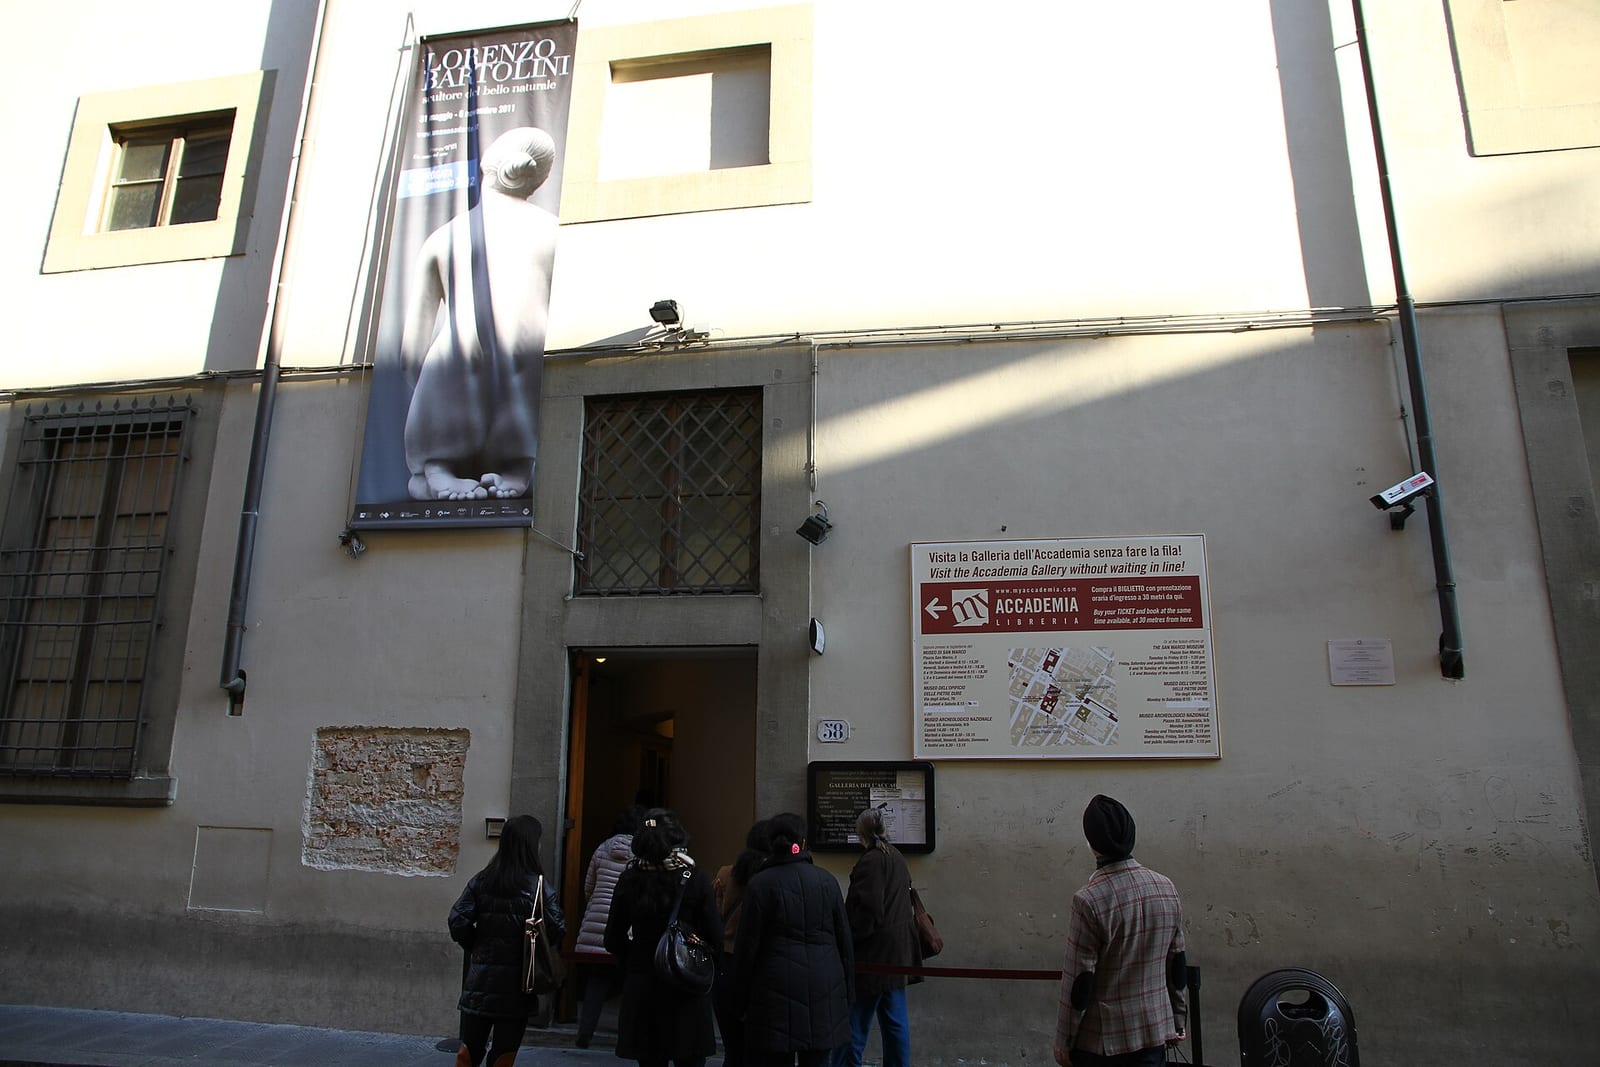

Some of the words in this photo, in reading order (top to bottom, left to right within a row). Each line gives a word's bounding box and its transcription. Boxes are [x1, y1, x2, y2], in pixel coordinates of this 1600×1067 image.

[427, 38, 556, 73] LORENZO
[422, 55, 571, 91] BARTOLINI
[481, 84, 510, 97] bello
[512, 80, 556, 94] naturale
[499, 103, 516, 113] 2011
[929, 552, 956, 563] Visita
[959, 551, 968, 562] la
[971, 550, 1010, 562] Galleria
[1013, 548, 1090, 560] dell'Accademia
[1093, 549, 1123, 558] senza
[1126, 546, 1147, 557] fare
[1150, 546, 1159, 556] la
[1162, 545, 1182, 556] fila!
[930, 567, 951, 579] Visit
[954, 567, 970, 578] the
[972, 565, 1028, 578] Accademia
[1031, 564, 1067, 577] Gallery
[1070, 562, 1108, 575] without
[1110, 561, 1147, 575] waiting
[1150, 561, 1160, 573] in
[1162, 560, 1185, 572] line!
[1091, 586, 1112, 594] Compra
[1157, 584, 1192, 593] prenotazione
[995, 597, 1079, 614] ACCADEMIA
[1091, 594, 1108, 602] oraria
[1109, 594, 1137, 602] d'ingresso
[996, 617, 1079, 626] LIBRERIA
[1093, 609, 1104, 617] Buy
